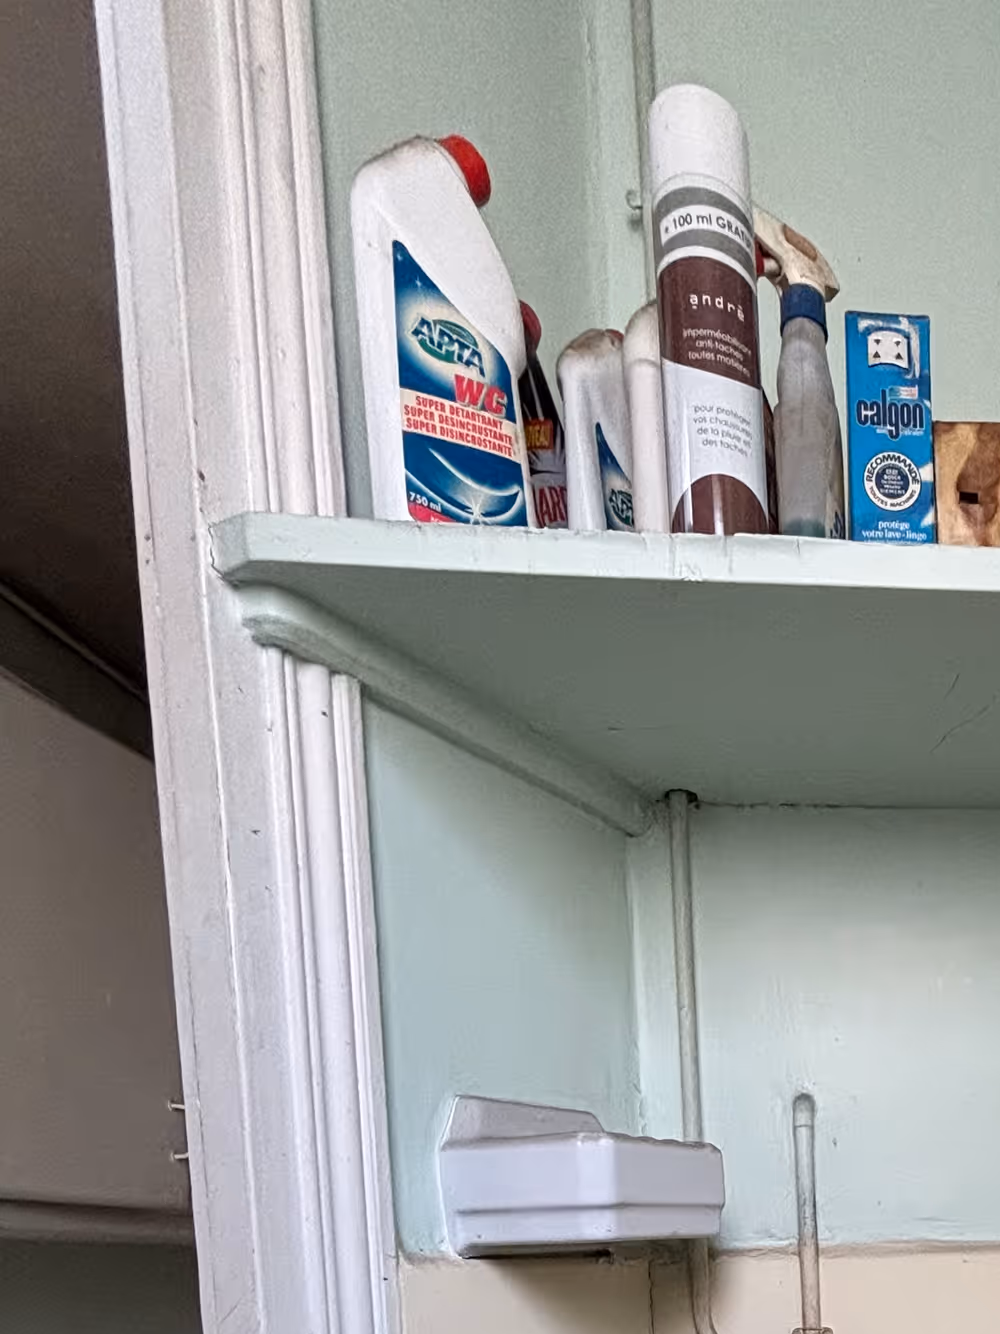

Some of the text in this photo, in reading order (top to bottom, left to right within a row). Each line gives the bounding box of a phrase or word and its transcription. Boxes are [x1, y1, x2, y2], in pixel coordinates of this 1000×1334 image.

[673, 213, 693, 230] 100
[696, 213, 712, 226] ml
[411, 317, 486, 378] APTA
[415, 396, 503, 431] SUPER DETARTRANT
[454, 373, 507, 417] WC
[856, 388, 925, 441] calgon
[404, 404, 513, 446] SUPER DESINCRUSTANTE
[406, 417, 513, 458] SUPER DISINCROSTANTE
[409, 491, 442, 512] 750 ml
[861, 530, 884, 538] votre
